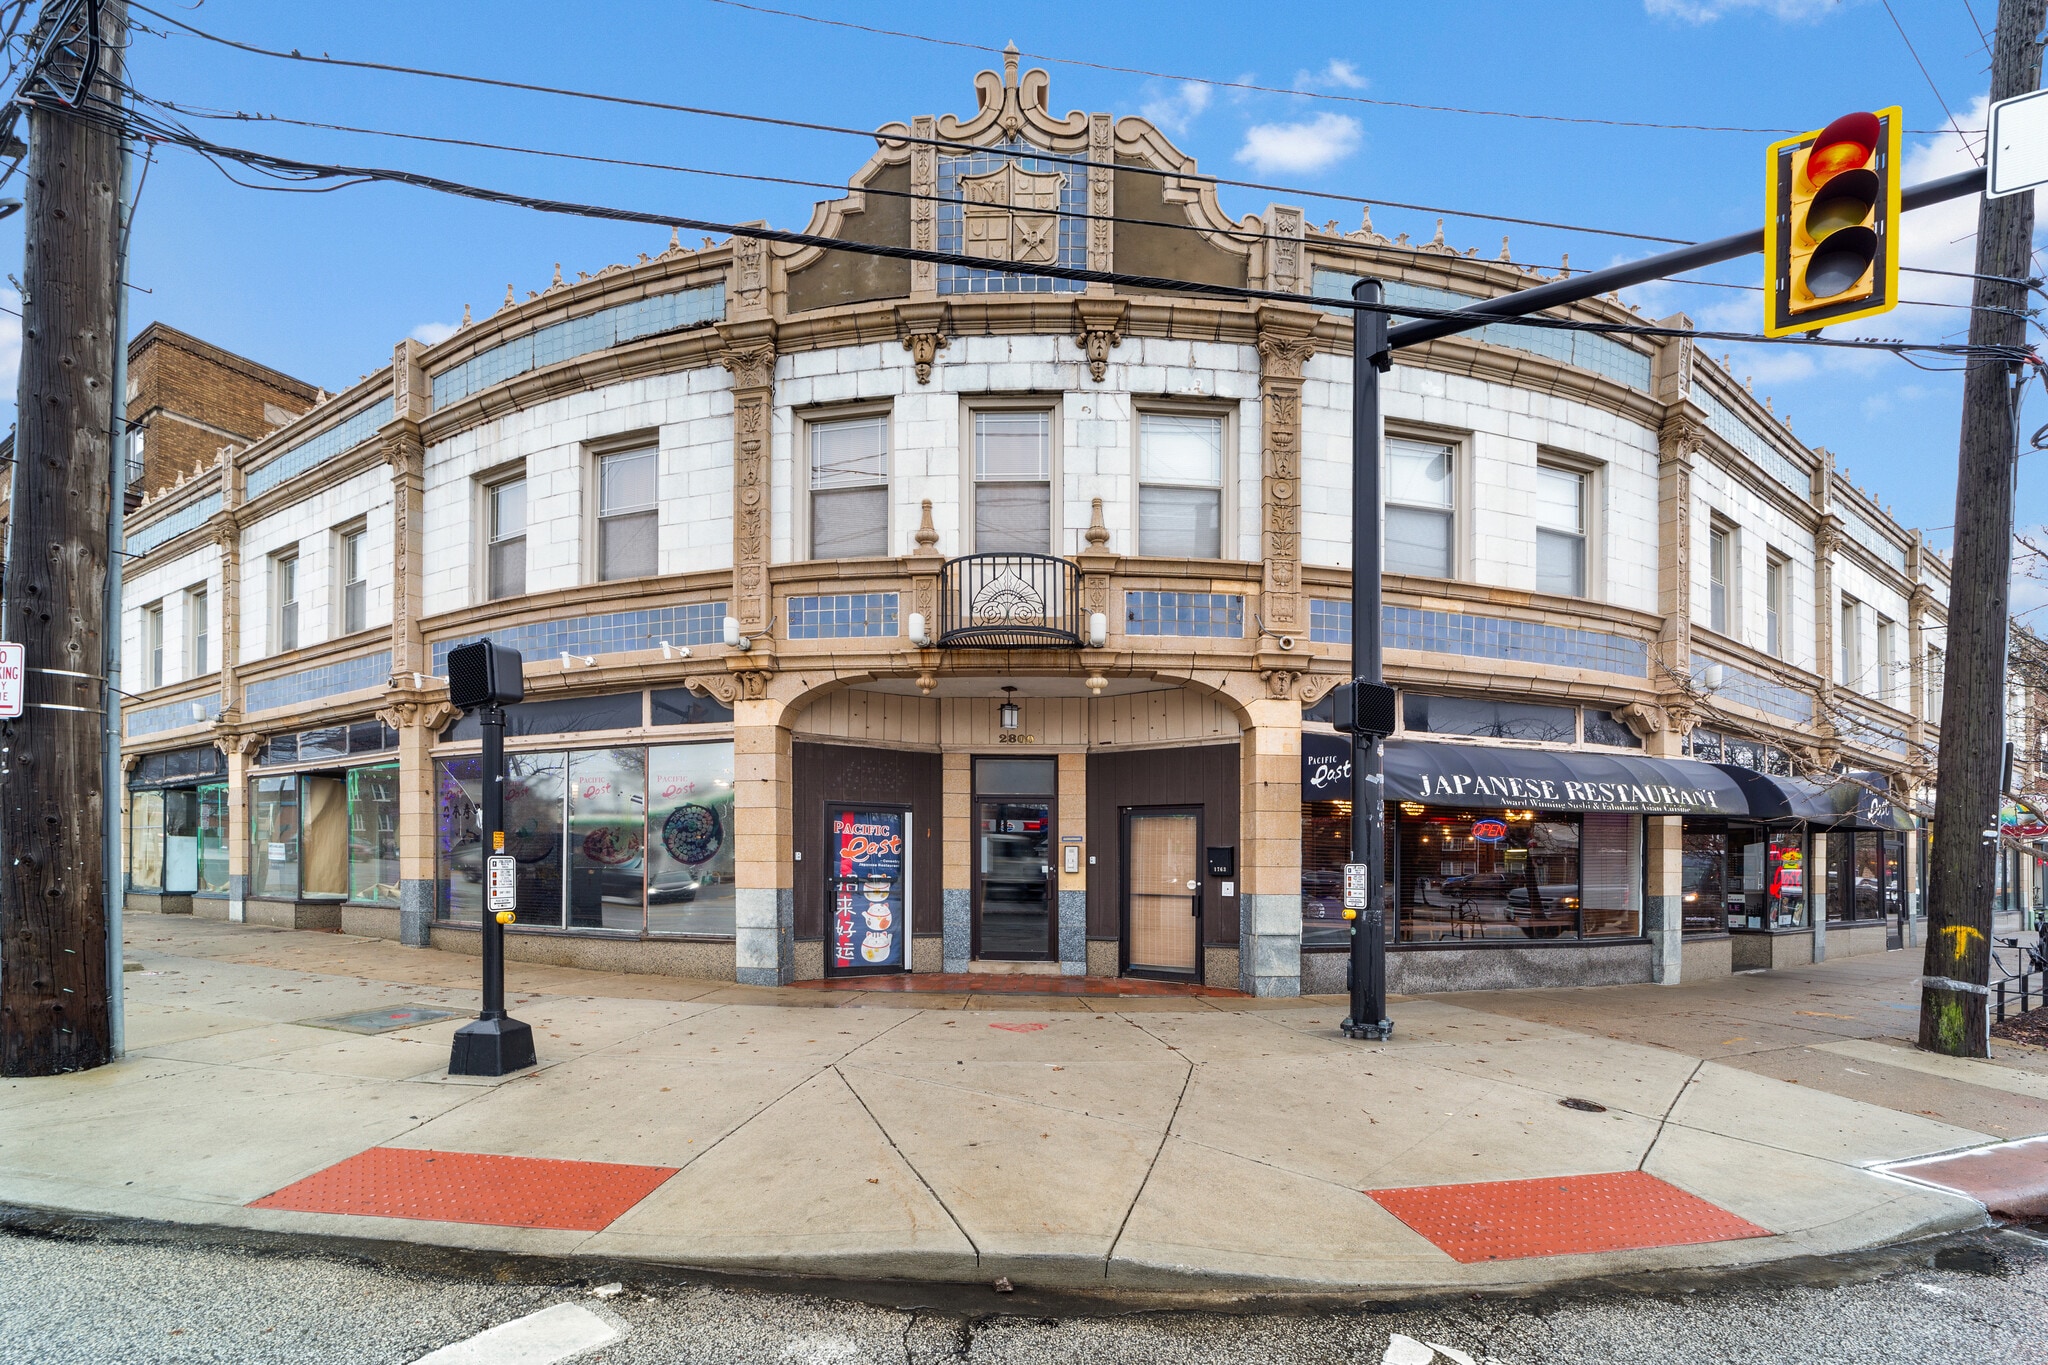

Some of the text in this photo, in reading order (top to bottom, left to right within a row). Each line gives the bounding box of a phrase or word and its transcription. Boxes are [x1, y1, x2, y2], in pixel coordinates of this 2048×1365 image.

[999, 733, 1035, 744] 2800
[1308, 755, 1337, 766] PACIFIC
[579, 776, 605, 784] PACIFIC
[658, 775, 688, 783] PACIFIC
[1419, 773, 1719, 809] JAPANESE RESTAURANT
[1500, 797, 1691, 813] Award Winning Sushi & Fabulous Asian Cuisine
[833, 820, 890, 837] PACIFIC
[1472, 823, 1507, 837] OPEN
